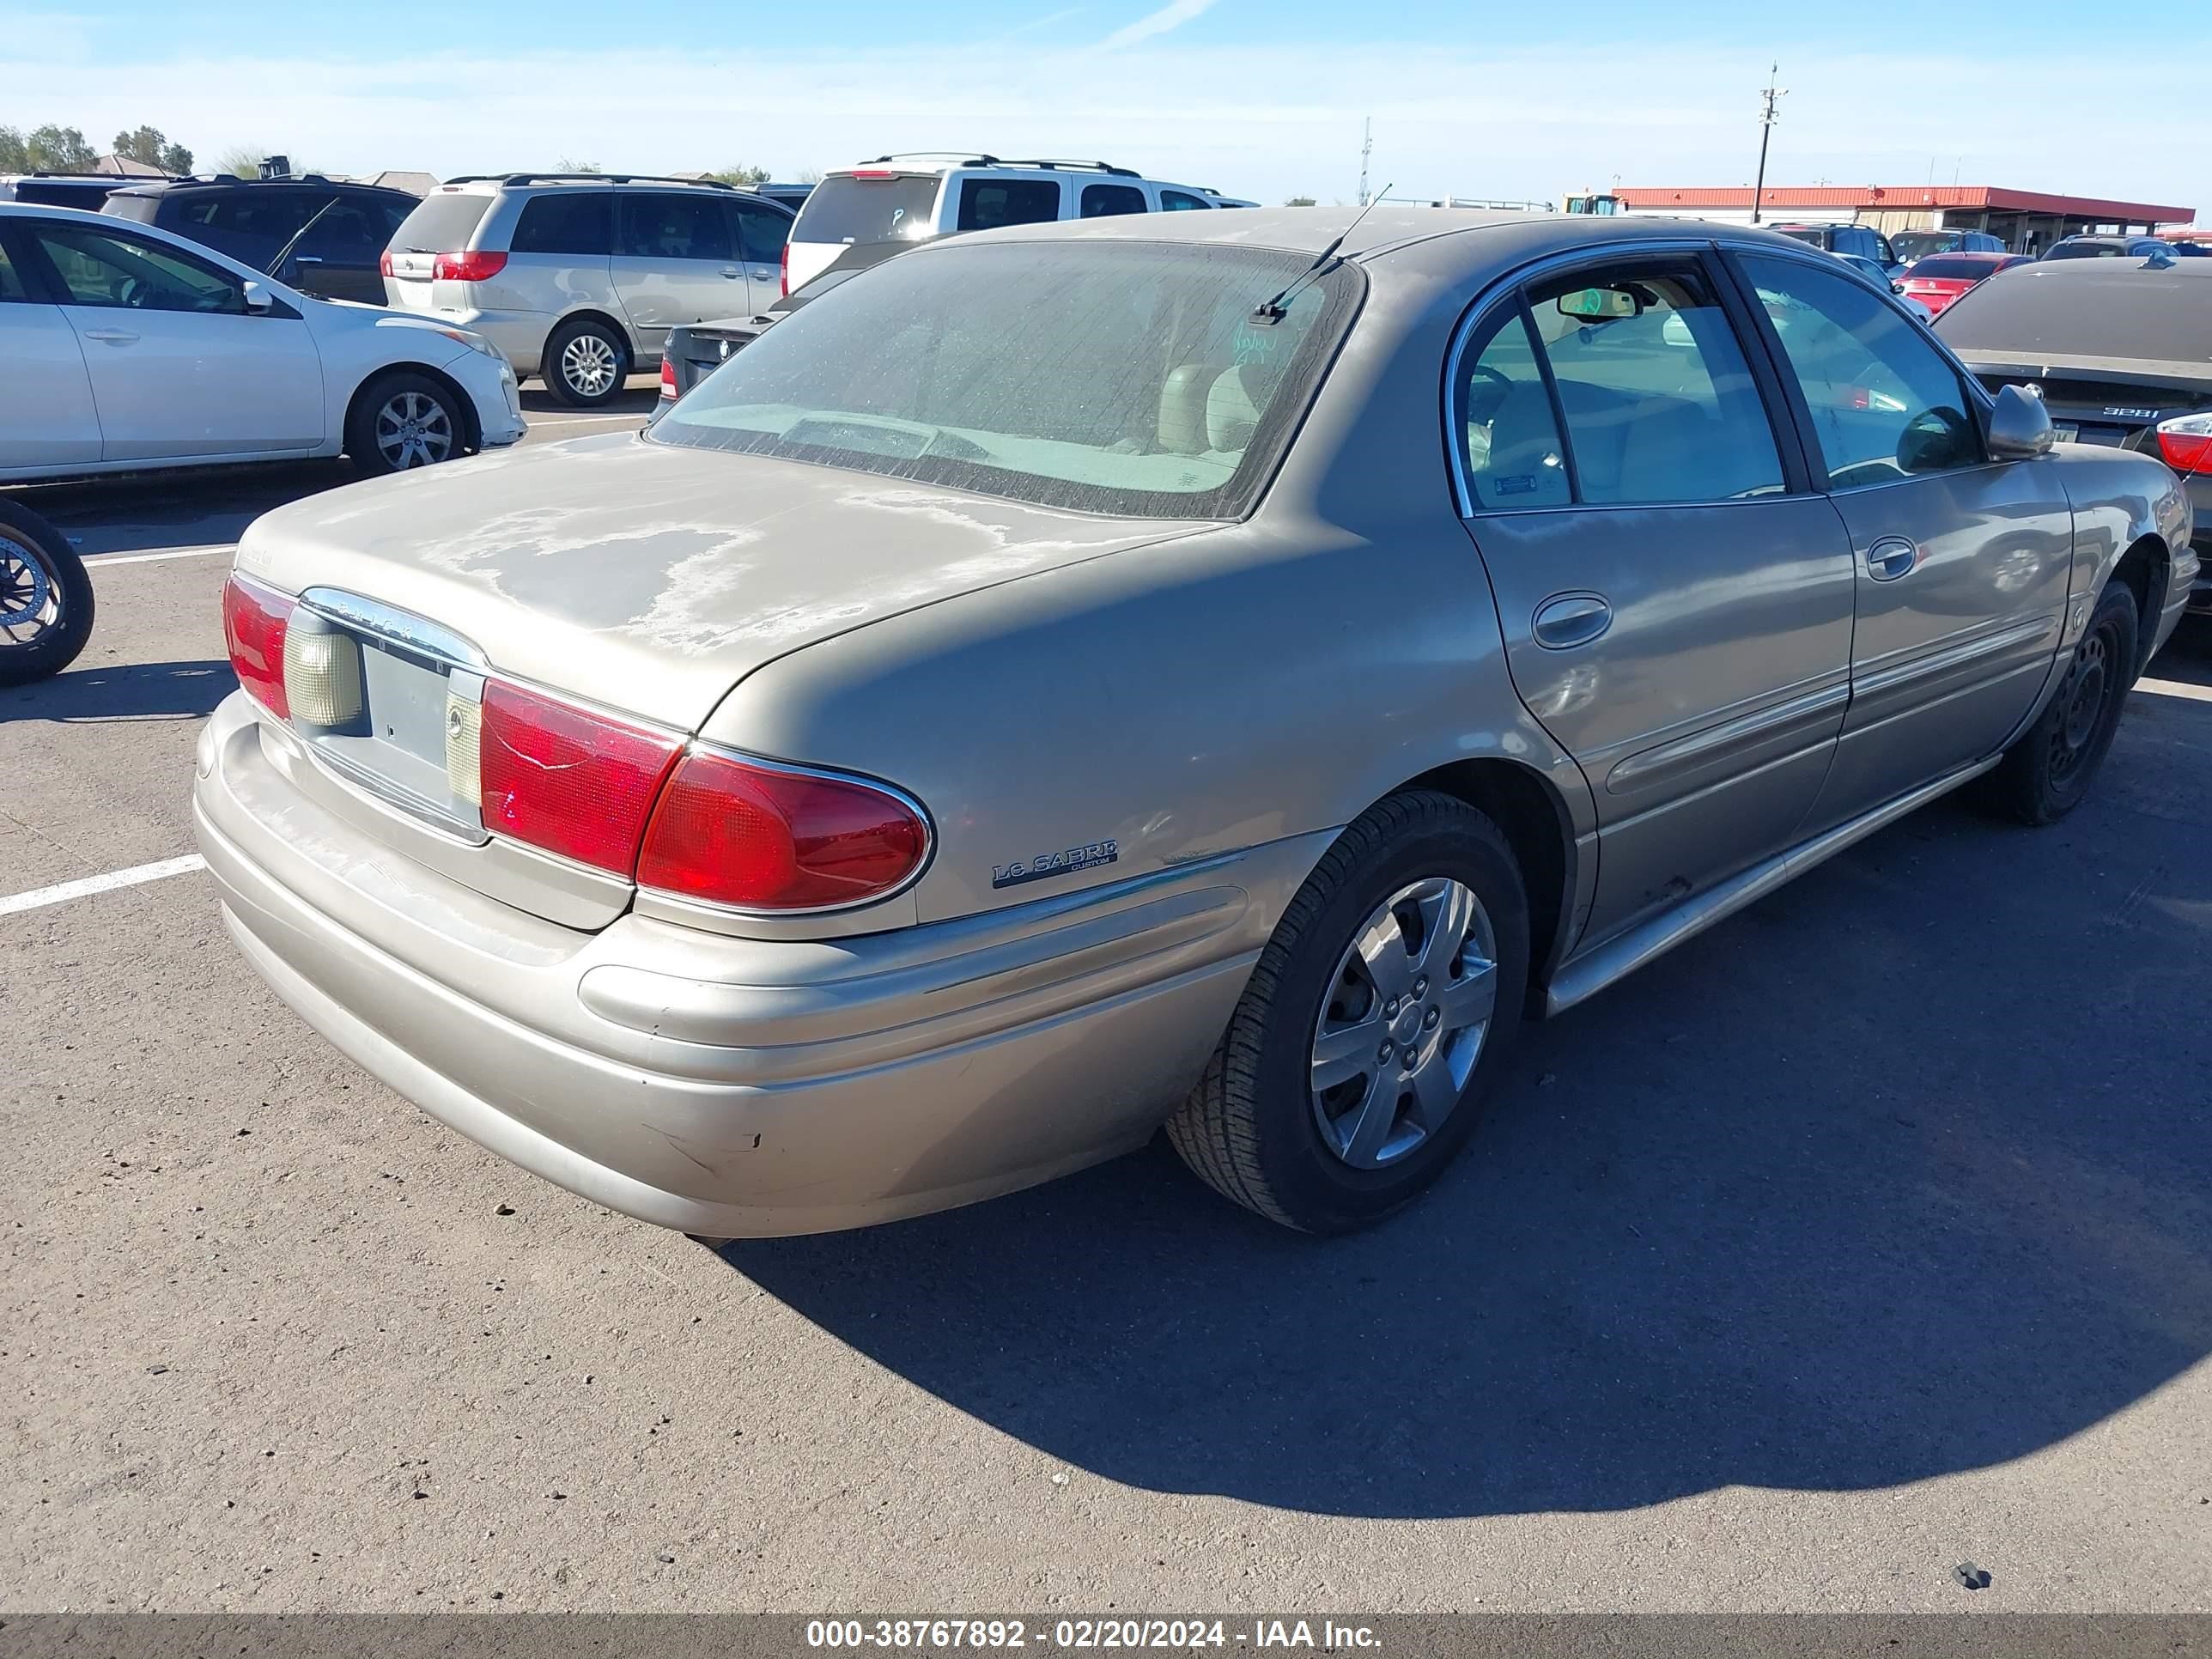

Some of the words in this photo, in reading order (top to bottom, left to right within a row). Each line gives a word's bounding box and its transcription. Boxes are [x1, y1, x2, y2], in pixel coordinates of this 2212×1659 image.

[893, 209, 904, 227] P
[337, 604, 412, 640] BUICK
[1034, 841, 1118, 872] SABRE
[1071, 857, 1109, 871] CUSTOM
